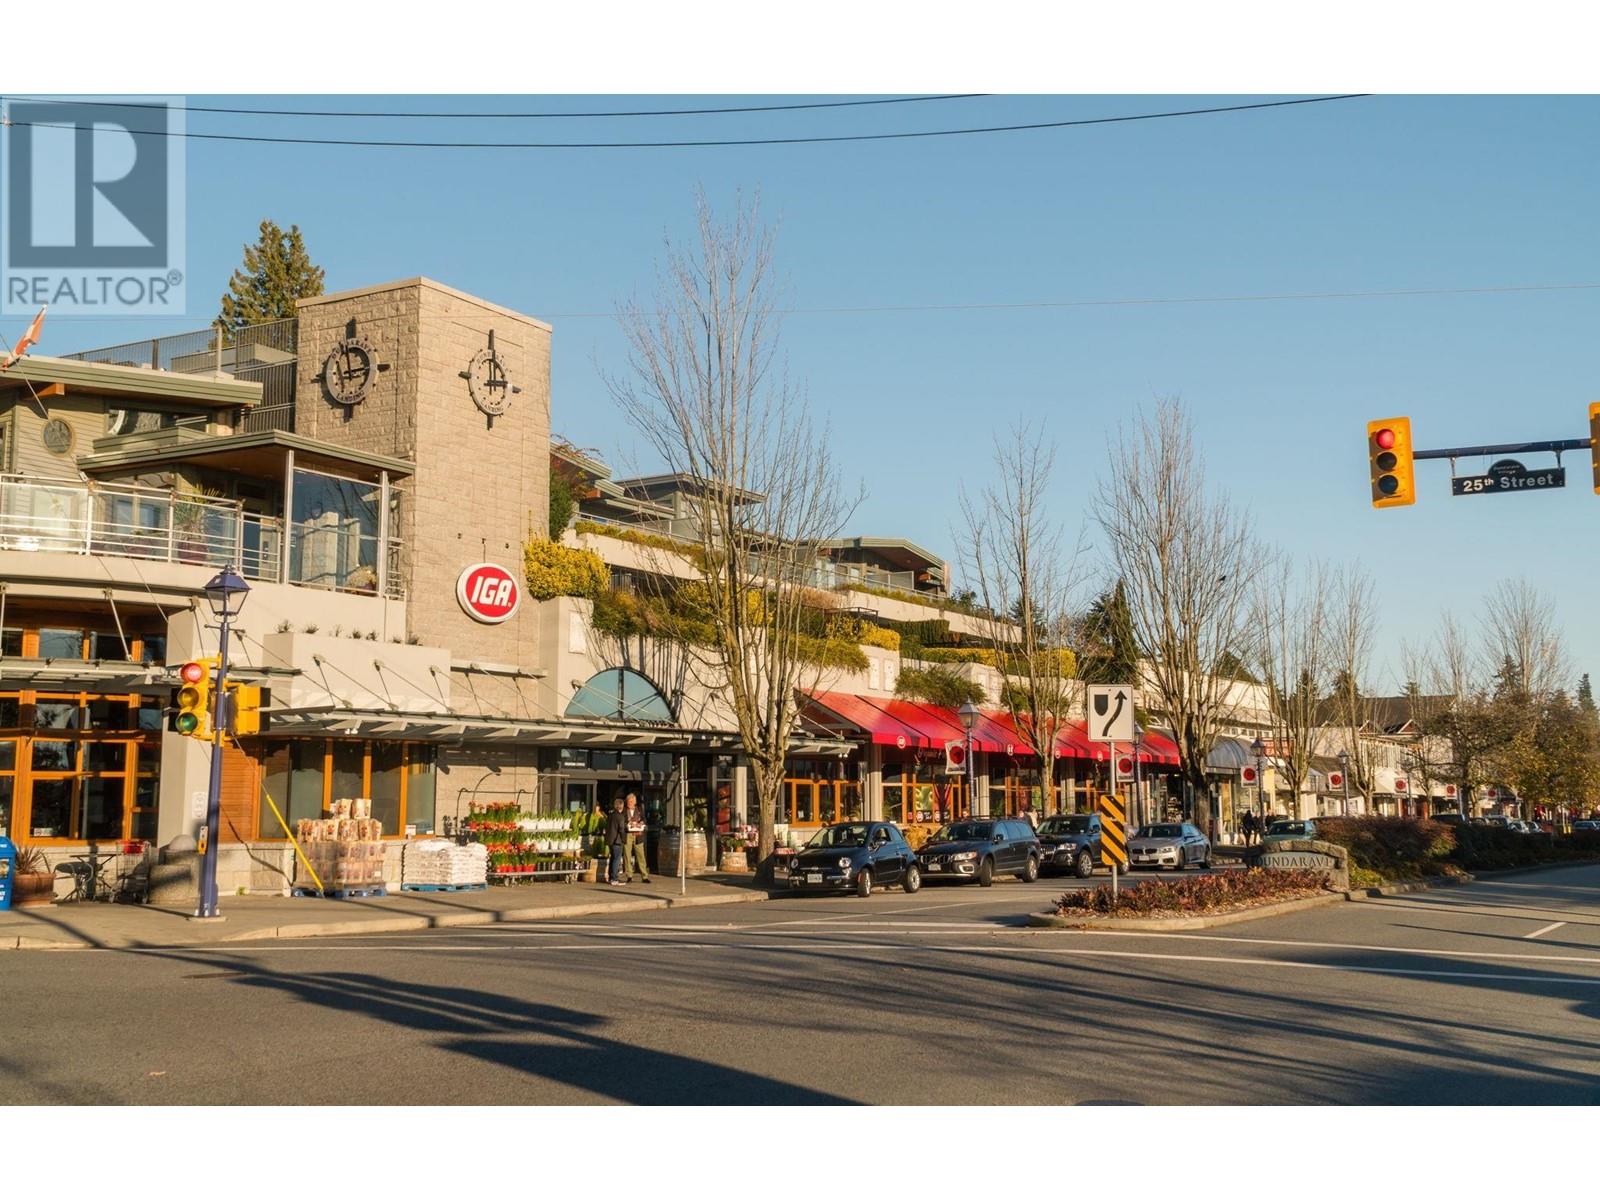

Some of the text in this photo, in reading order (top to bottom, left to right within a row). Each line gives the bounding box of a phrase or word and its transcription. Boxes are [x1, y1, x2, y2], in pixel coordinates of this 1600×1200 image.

[1463, 473, 1554, 492] 25th Street
[471, 576, 513, 607] IGA
